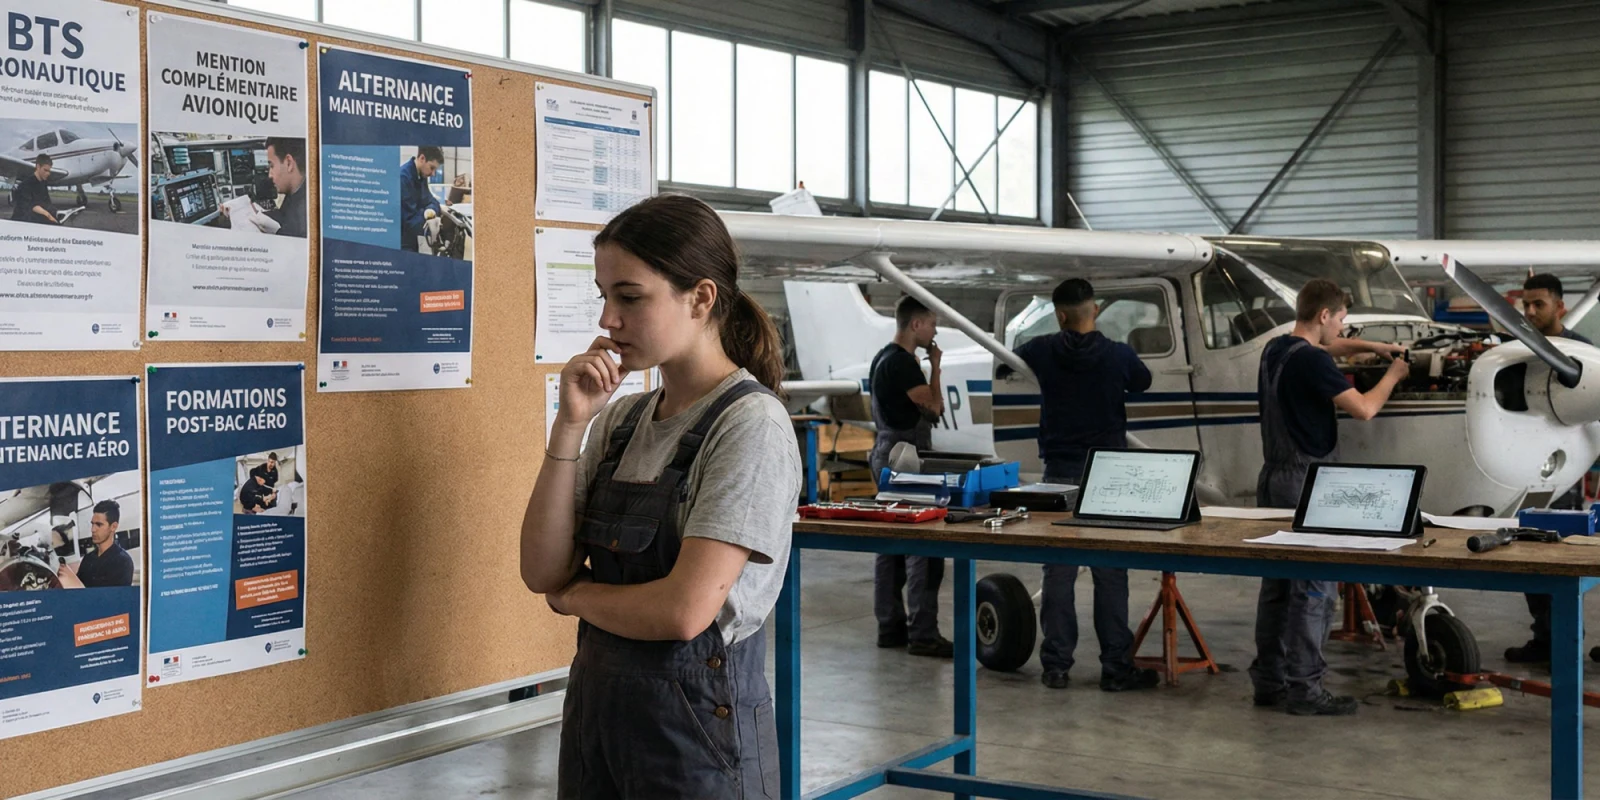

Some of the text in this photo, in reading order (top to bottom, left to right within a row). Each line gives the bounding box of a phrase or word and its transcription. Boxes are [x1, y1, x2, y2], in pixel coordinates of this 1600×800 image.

[8, 12, 84, 59] BTS
[196, 51, 265, 76] MENTION
[161, 68, 298, 102] COMPLÉMENTAIRE
[338, 70, 454, 107] ALTERNANCE
[182, 94, 279, 124] AVIONIQUE
[329, 96, 464, 129] MAINTENANCE AÉRO
[166, 387, 287, 411] FORMATIONS
[0, 411, 121, 440] TERNANCE
[166, 409, 287, 434] POST-BAC AÉRO
[86, 436, 130, 458] AÉRO
